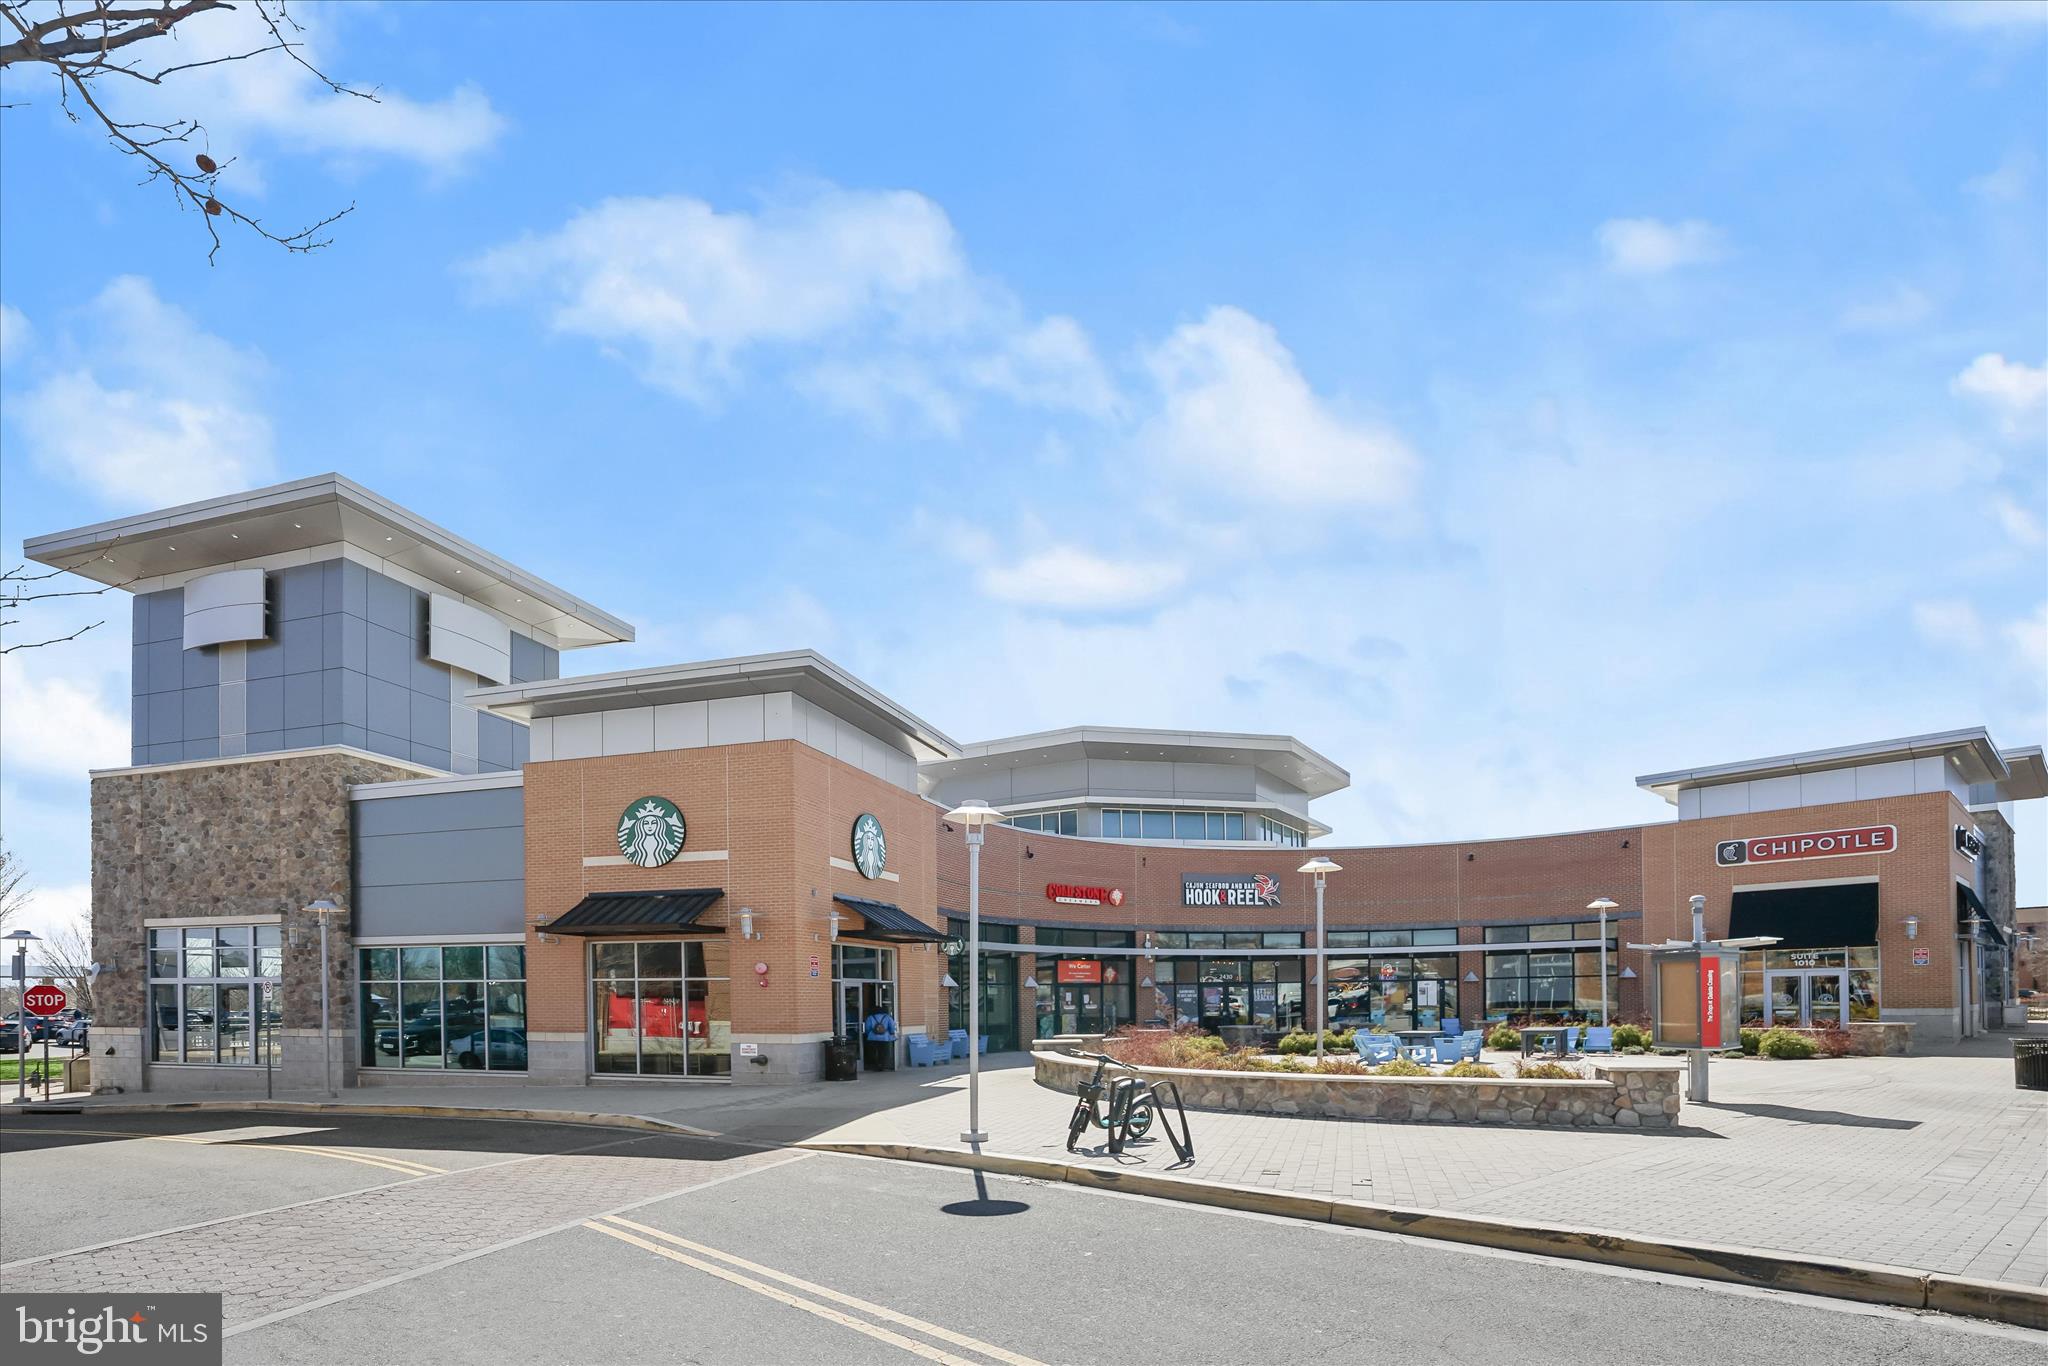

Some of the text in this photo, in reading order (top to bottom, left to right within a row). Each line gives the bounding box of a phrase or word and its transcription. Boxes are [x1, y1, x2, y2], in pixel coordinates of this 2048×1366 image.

[1753, 832, 1886, 857] CHIPOTLE
[1185, 889, 1221, 905] HOOK
[1227, 889, 1265, 905] REEL
[1790, 952, 1819, 960] SUITE
[26, 994, 65, 1007] STOP
